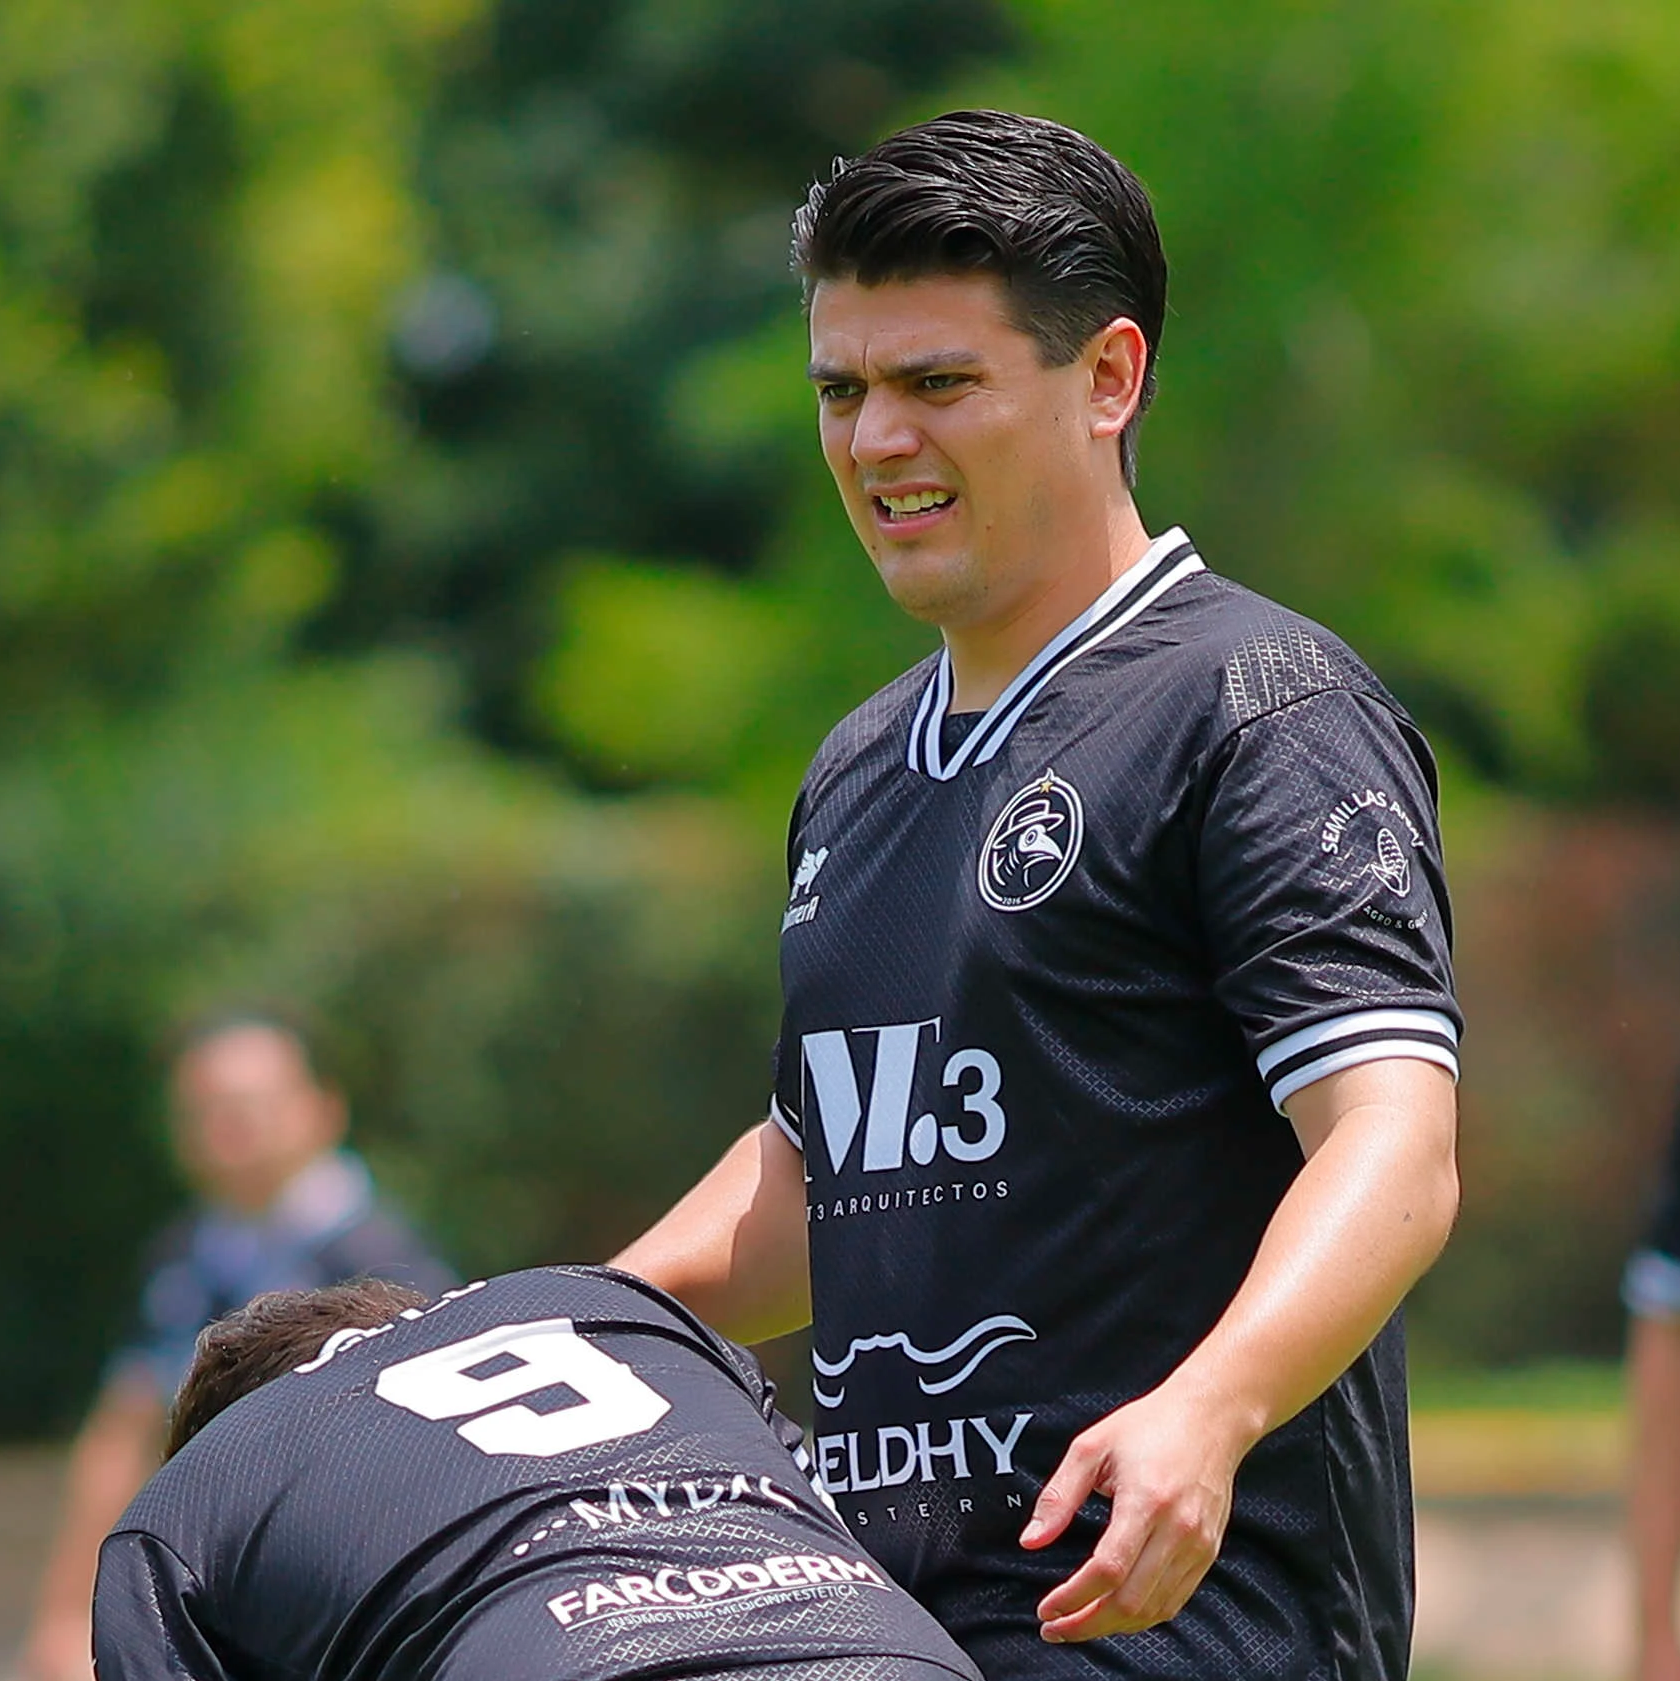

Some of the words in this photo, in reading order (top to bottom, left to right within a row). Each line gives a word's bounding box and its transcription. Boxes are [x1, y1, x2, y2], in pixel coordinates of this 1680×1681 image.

[1321, 789, 1387, 854] SEMILLAS
[806, 1204, 825, 1223] T3
[833, 1181, 1009, 1217] ARQUITECTOS
[374, 1317, 673, 1458] 9
[817, 1413, 1034, 1494] ELDHY
[857, 1494, 1022, 1526] STERN
[547, 1555, 882, 1625] FARCODERM
[716, 1592, 793, 1616] MEDICINA
